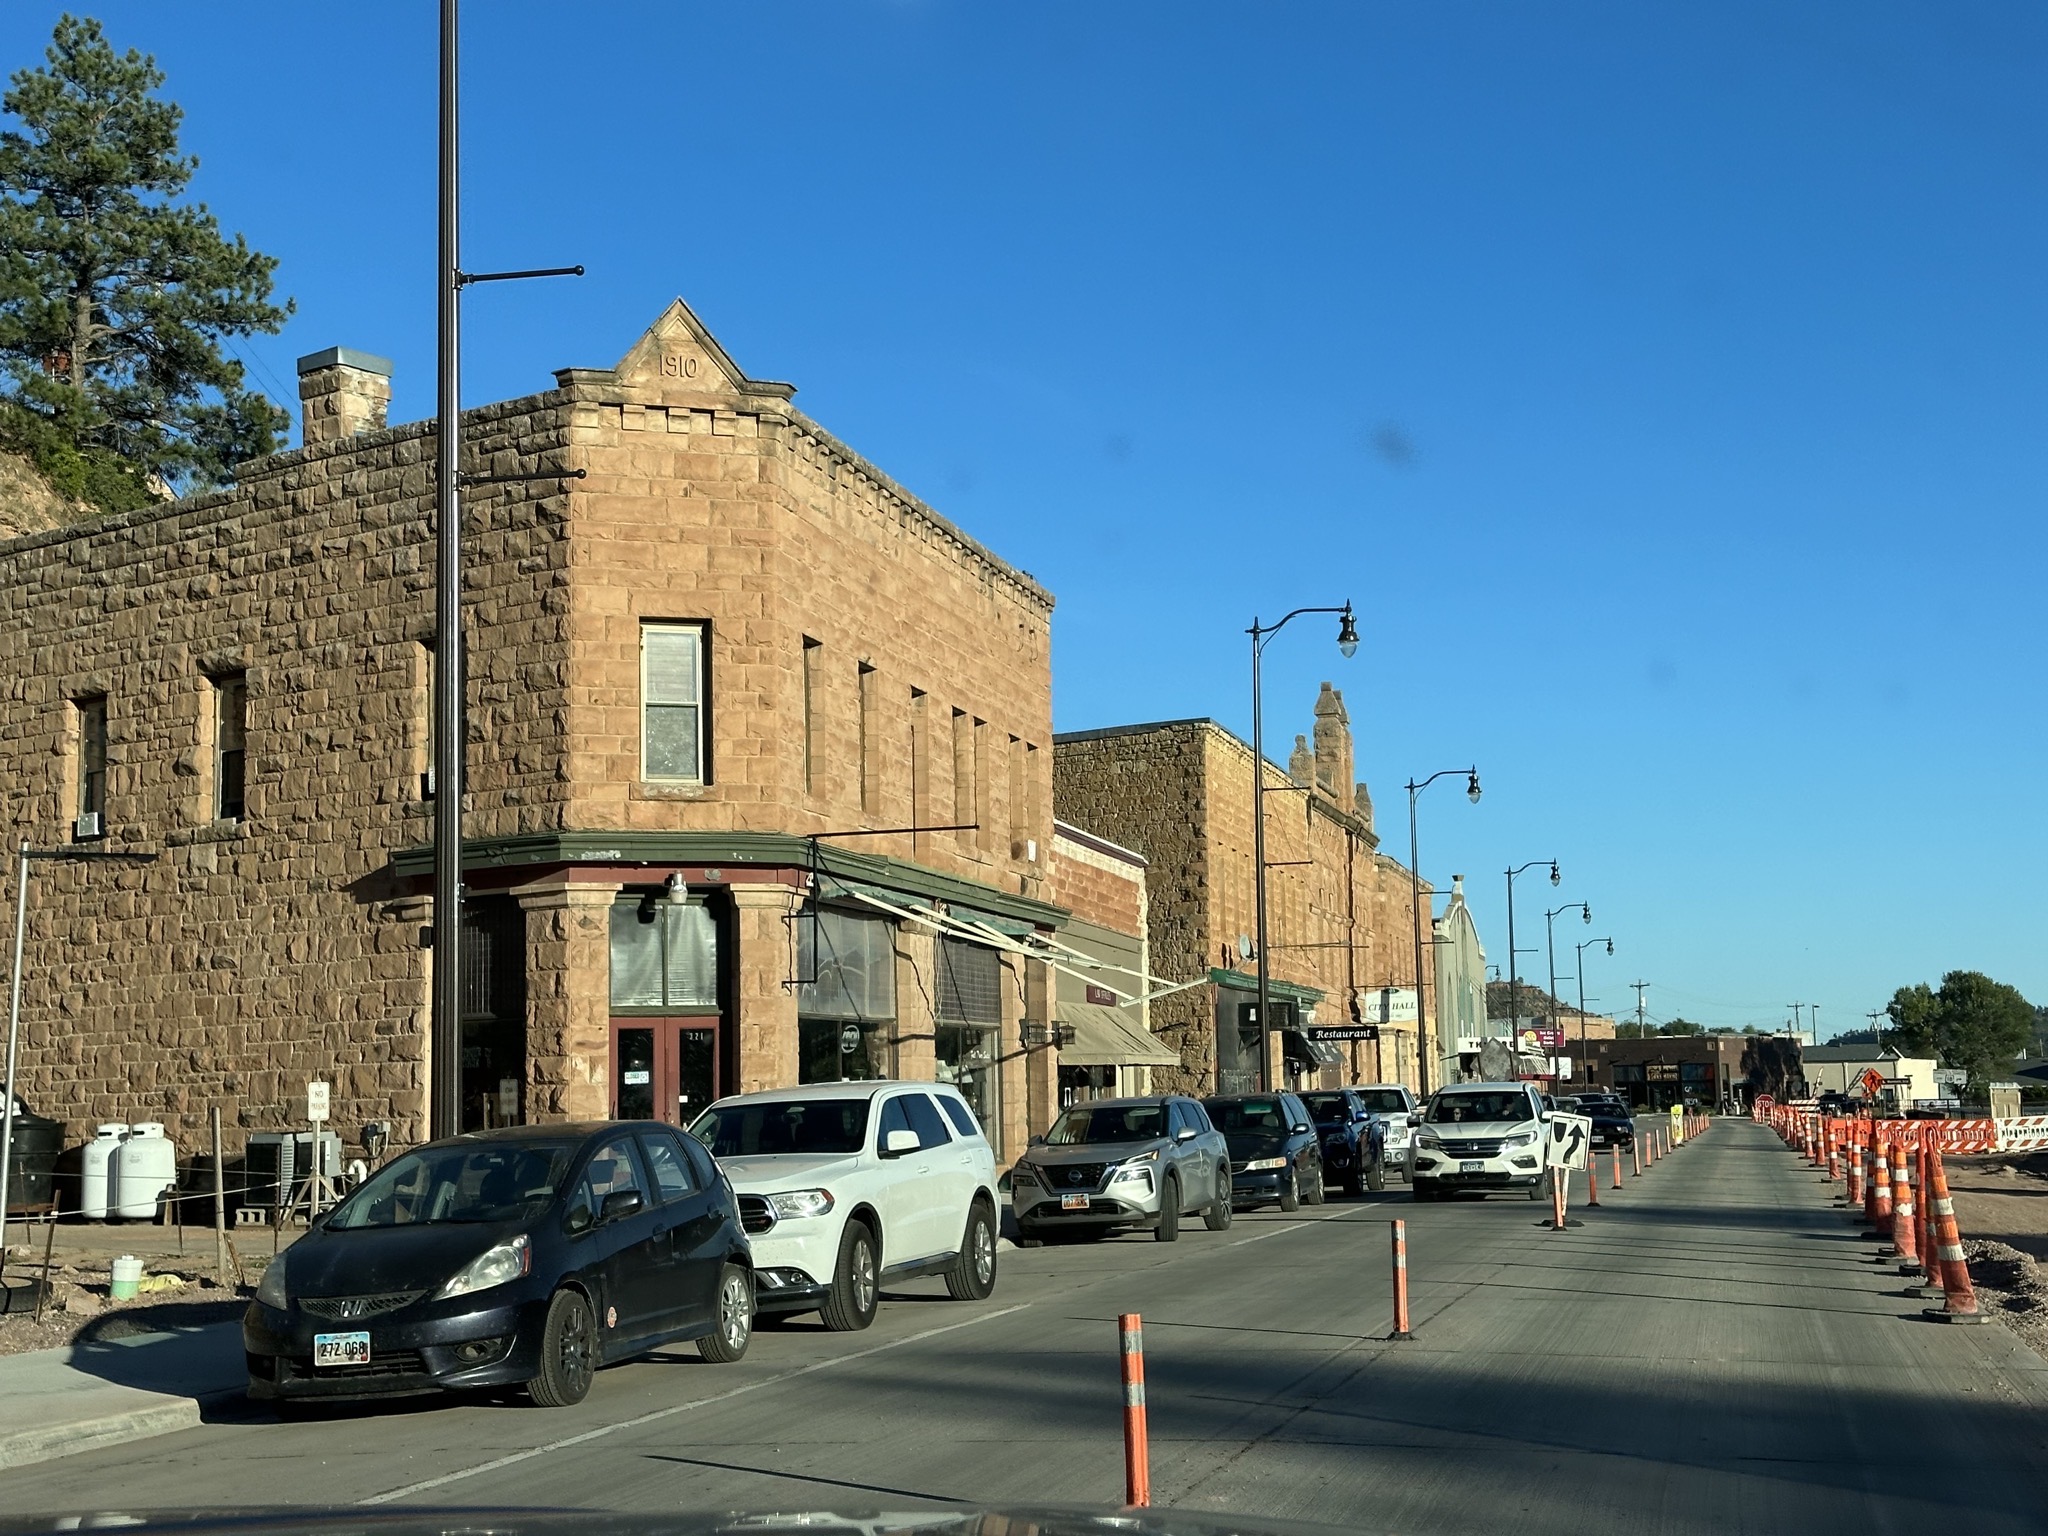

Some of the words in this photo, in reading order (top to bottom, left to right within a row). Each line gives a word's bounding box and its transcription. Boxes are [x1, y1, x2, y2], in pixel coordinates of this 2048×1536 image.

[659, 354, 698, 378] 1910
[1368, 1003, 1390, 1012] CITY
[1392, 1001, 1416, 1010] HALL
[1316, 1029, 1371, 1039] Restaurant
[314, 1090, 324, 1098] NO
[1757, 1100, 1774, 1108] STOP
[320, 1342, 341, 1357] 27Z
[344, 1341, 365, 1356] 068
